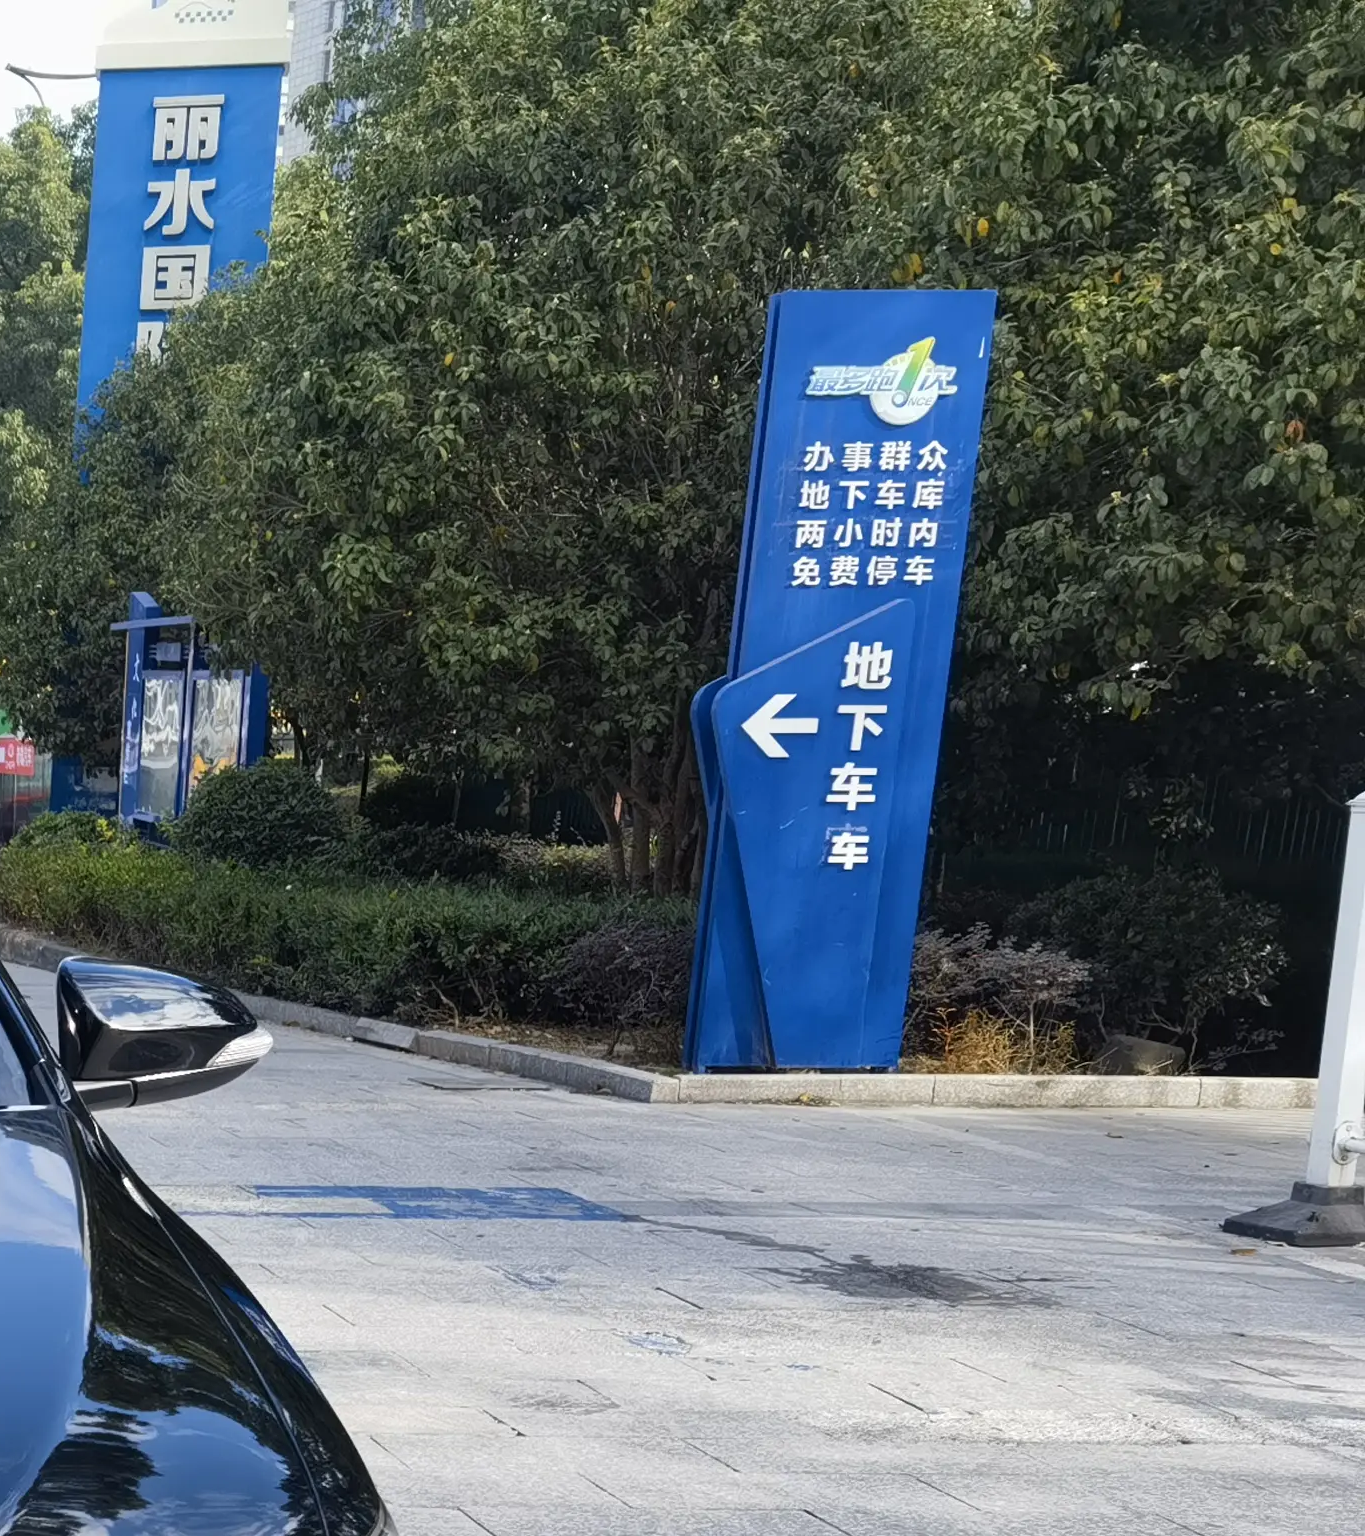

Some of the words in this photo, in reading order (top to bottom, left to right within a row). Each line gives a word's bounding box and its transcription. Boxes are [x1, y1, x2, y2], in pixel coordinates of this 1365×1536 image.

[135, 94, 225, 362] 丽水国
[802, 440, 948, 472] 办事群众
[798, 479, 945, 510] 地下车库
[795, 517, 938, 548] 两小时内
[791, 556, 935, 586] 免费停车
